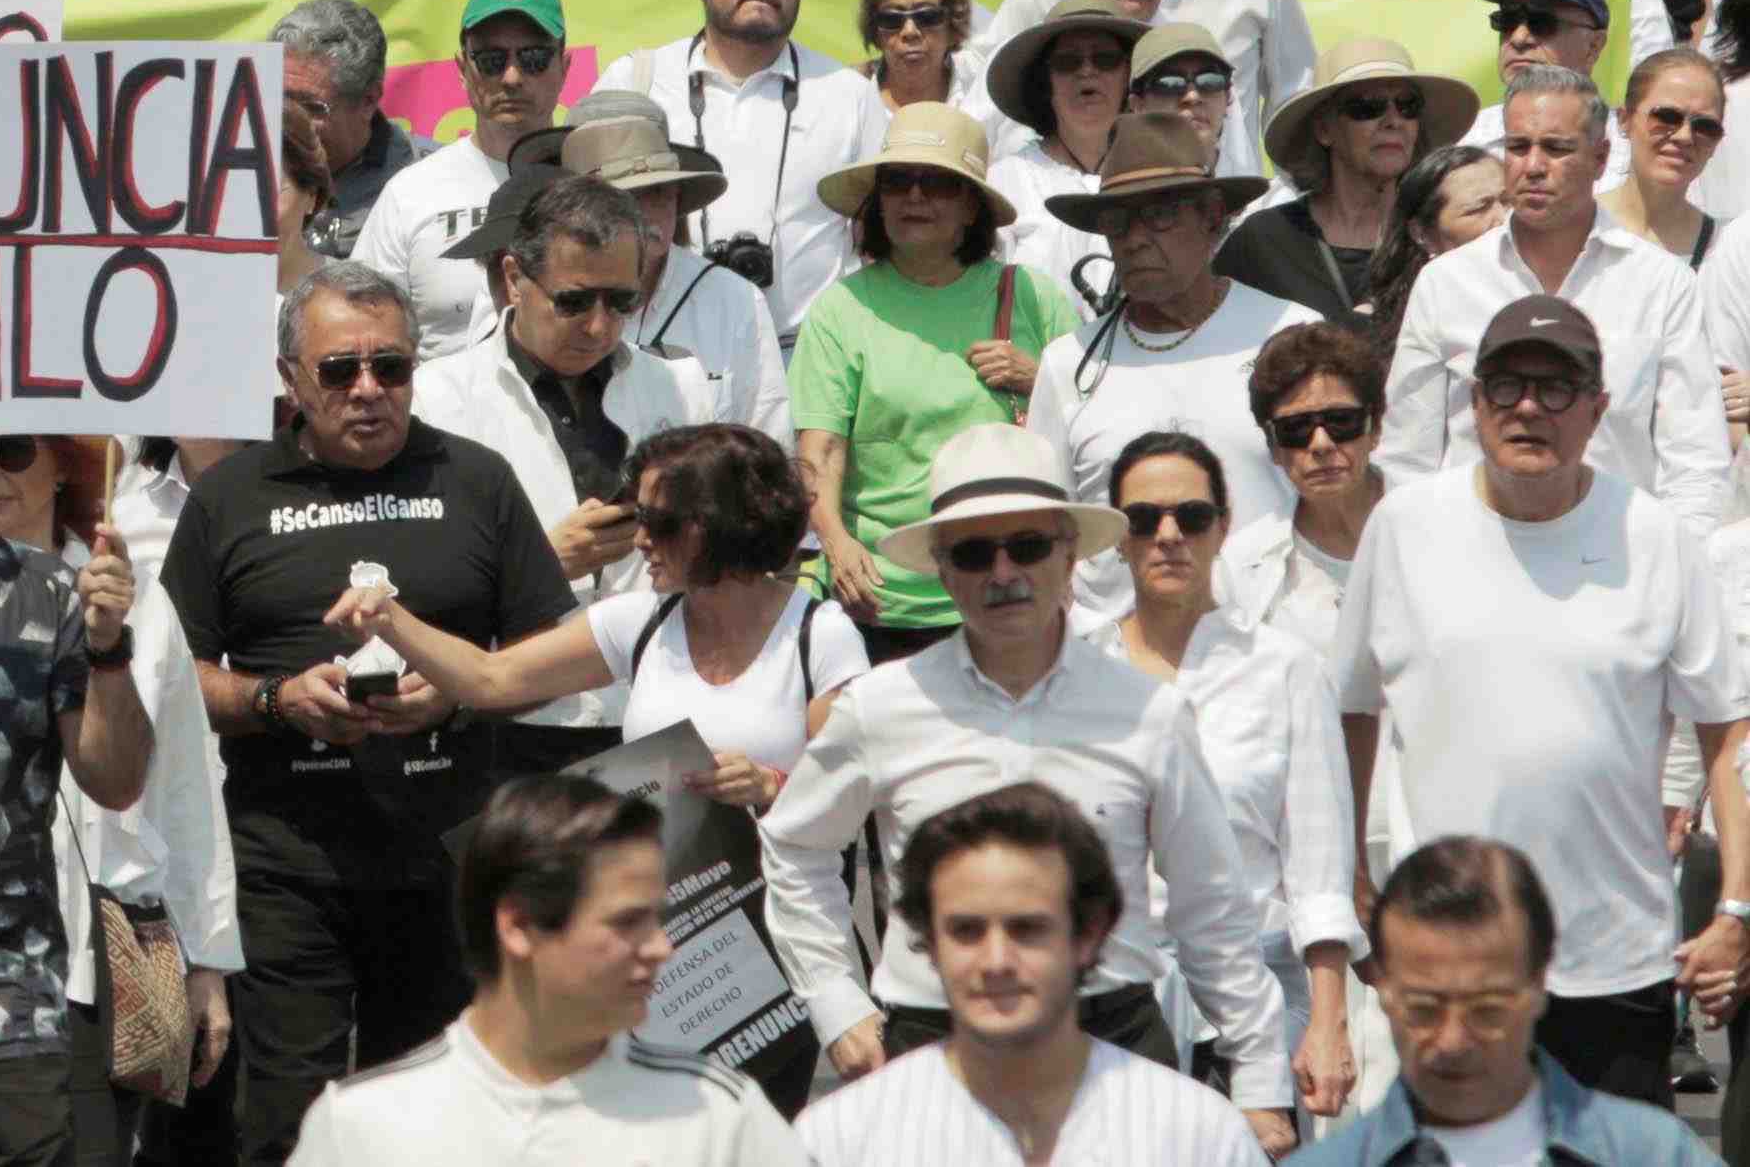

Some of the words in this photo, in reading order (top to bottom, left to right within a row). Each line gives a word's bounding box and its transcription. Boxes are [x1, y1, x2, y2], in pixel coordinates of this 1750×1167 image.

[269, 493, 445, 535] #SeCansoElGanso
[654, 949, 713, 995] DEFENSA
[711, 929, 740, 956] DEL
[661, 974, 715, 1019] ESTADO
[713, 960, 737, 983] DE
[679, 985, 744, 1036] DERECHO
